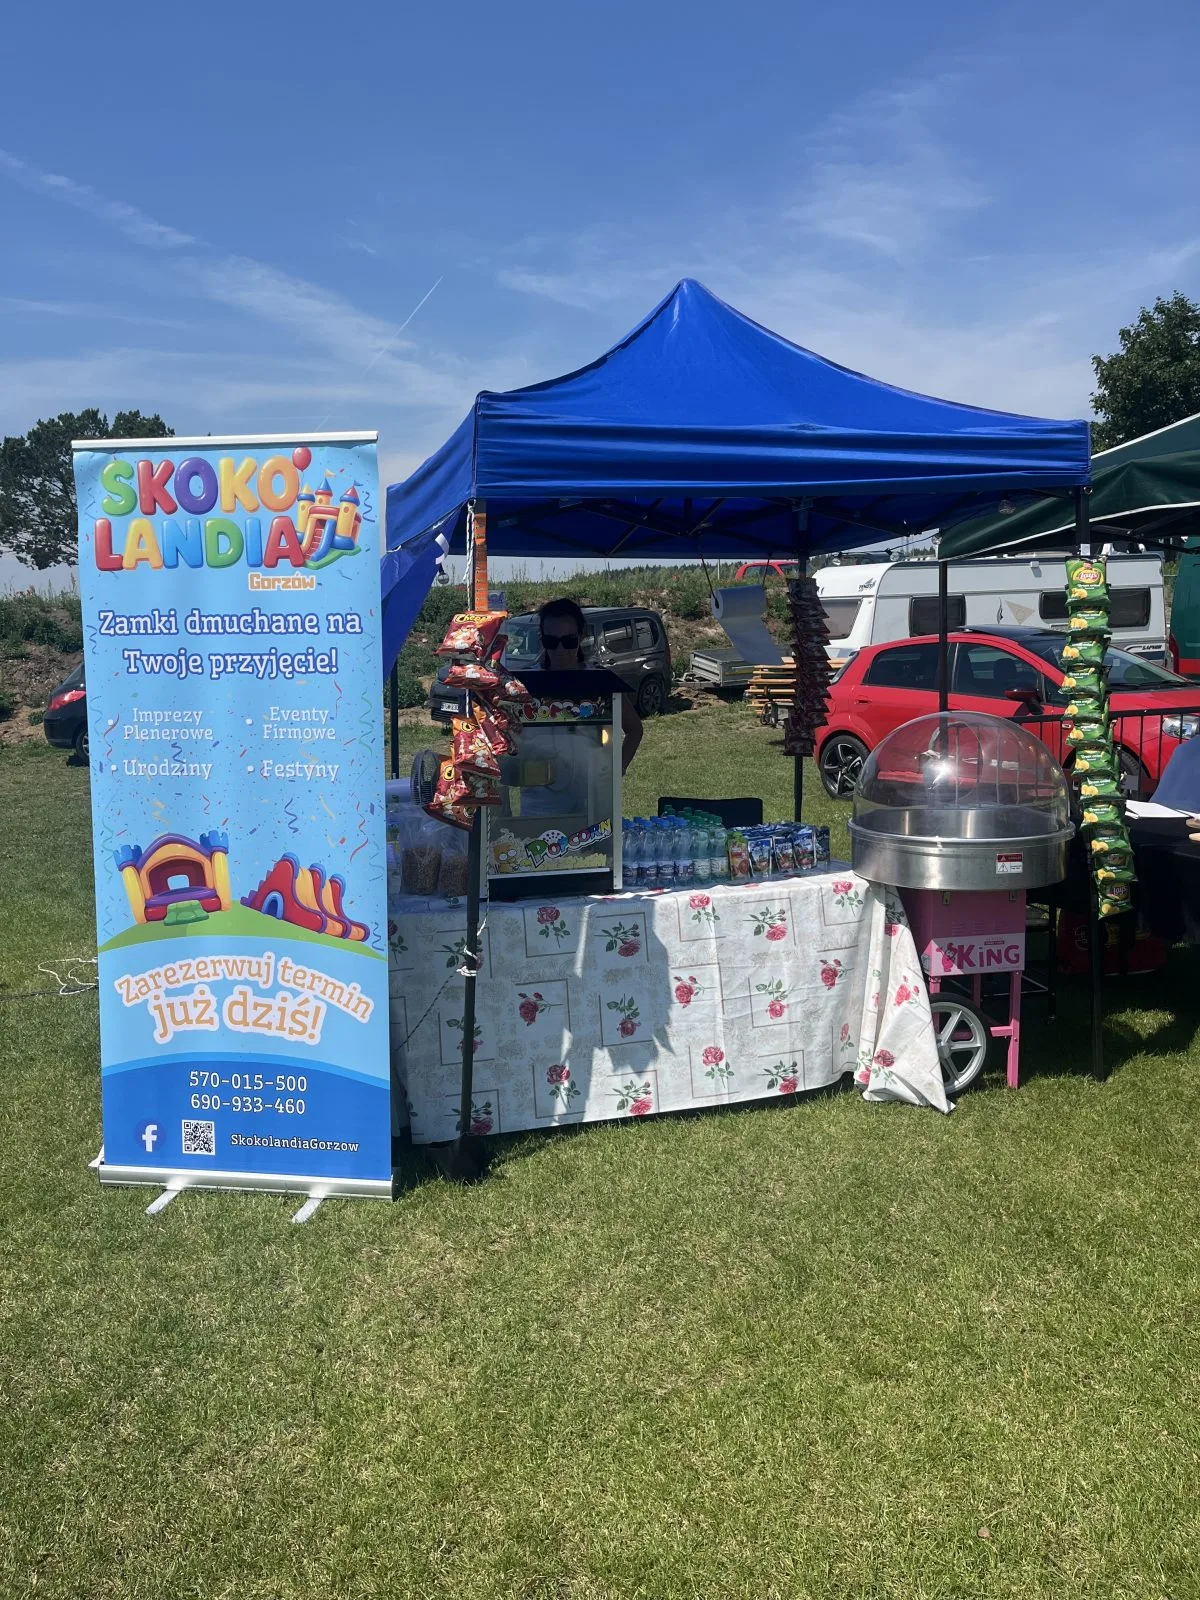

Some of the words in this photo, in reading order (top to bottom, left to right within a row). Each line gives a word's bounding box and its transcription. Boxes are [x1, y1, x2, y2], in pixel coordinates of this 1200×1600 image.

[101, 456, 300, 515] SKOKO
[94, 516, 305, 571] LANDIA
[249, 572, 315, 590] Gorzów
[99, 608, 178, 635] Zamki
[185, 608, 319, 635] dmuchane
[326, 611, 362, 635] na
[123, 649, 203, 678] Twoje
[209, 648, 338, 679] przyjęcie!
[132, 708, 203, 725] Imprezy
[269, 706, 329, 724] Eventy
[123, 725, 214, 741] Plenerowe
[262, 724, 336, 740] Firmowe
[123, 759, 213, 780] Urodziny
[261, 760, 339, 781] Festyny
[116, 955, 273, 1004] Zarezerwuj
[280, 959, 373, 1020] termin
[153, 989, 216, 1039] już
[227, 991, 323, 1040] dziś!
[189, 1071, 307, 1092] 570-015-500
[190, 1094, 306, 1115] 690-933-460
[230, 1134, 359, 1152] SkokolandiaGorzow
